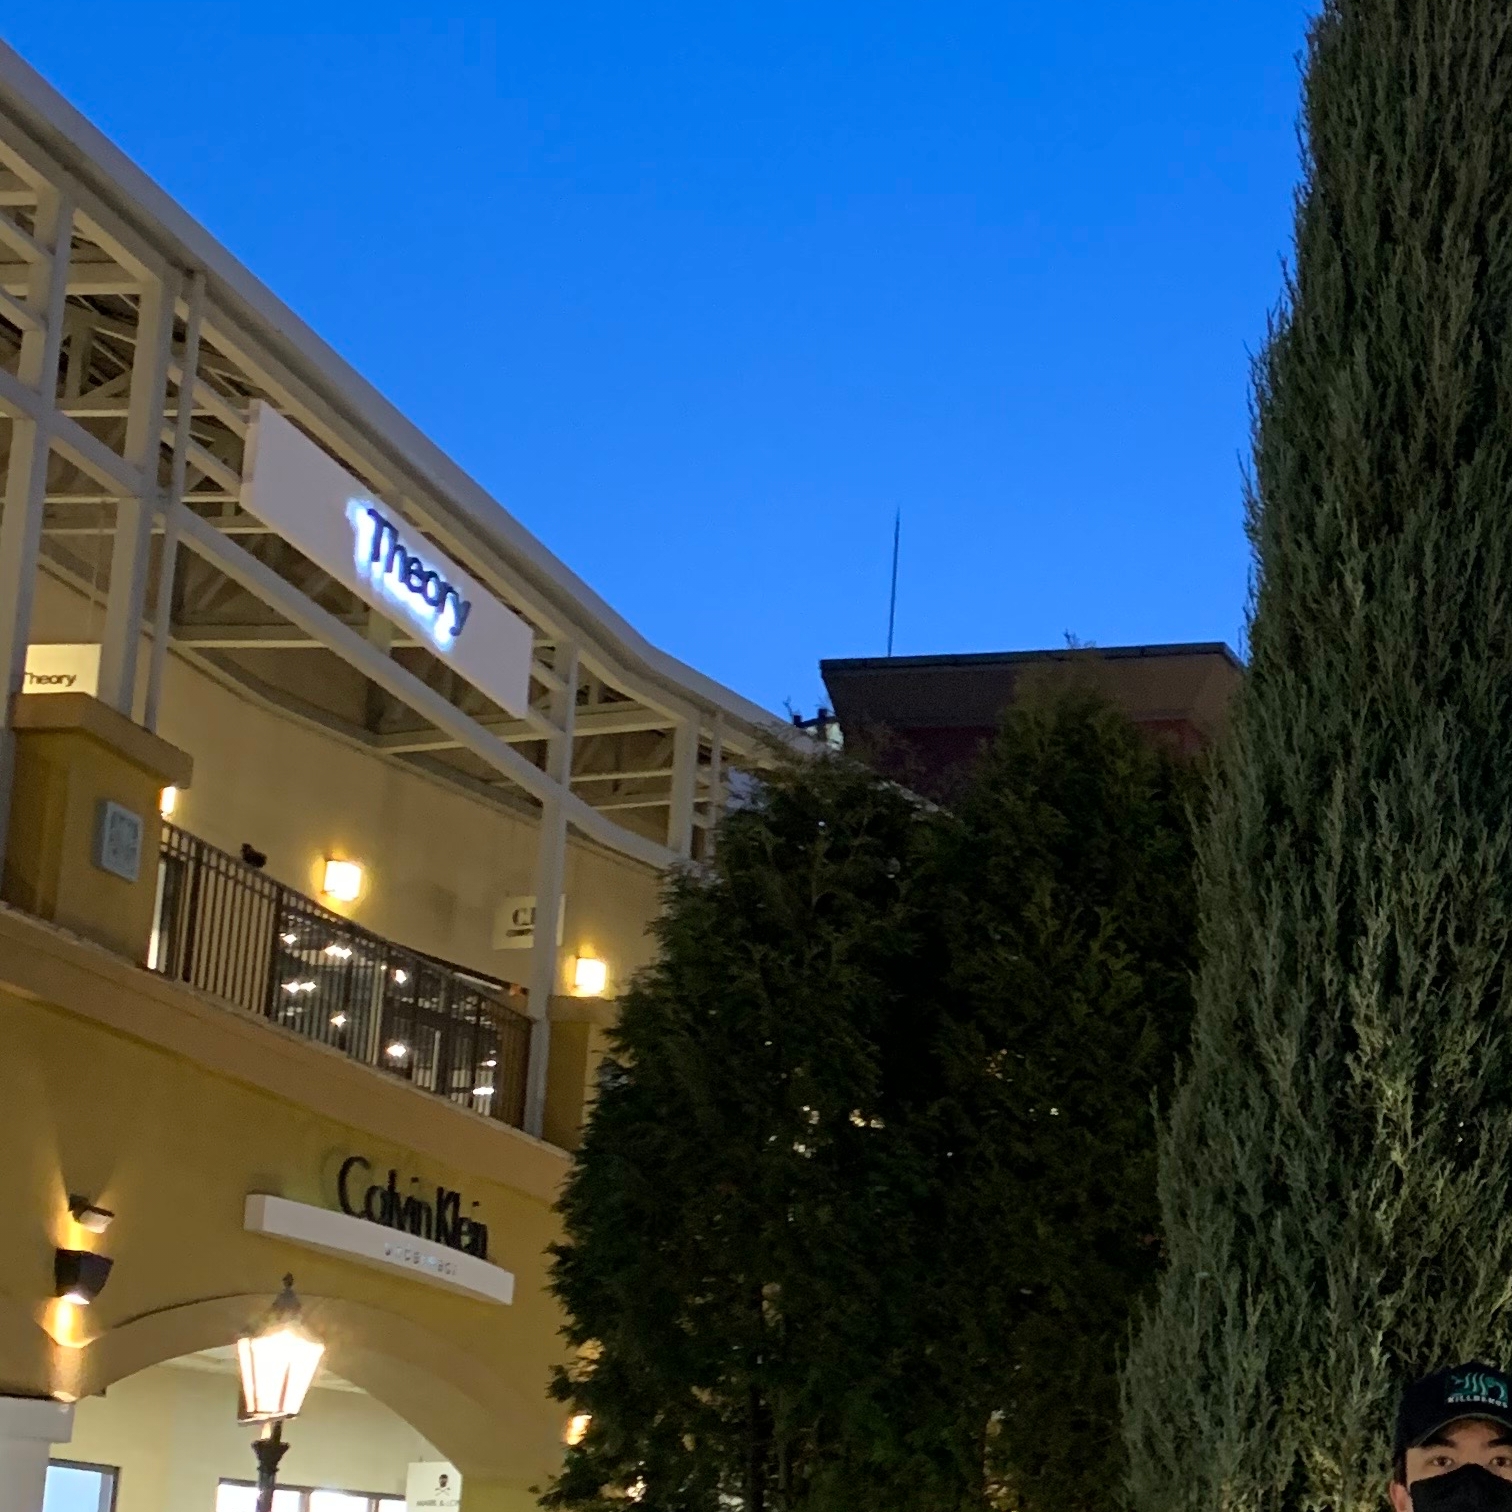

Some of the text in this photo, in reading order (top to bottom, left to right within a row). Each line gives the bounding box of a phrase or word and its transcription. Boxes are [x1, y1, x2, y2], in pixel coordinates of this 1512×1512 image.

[366, 507, 472, 637] Theory
[338, 1156, 488, 1260] Calvin Klein
